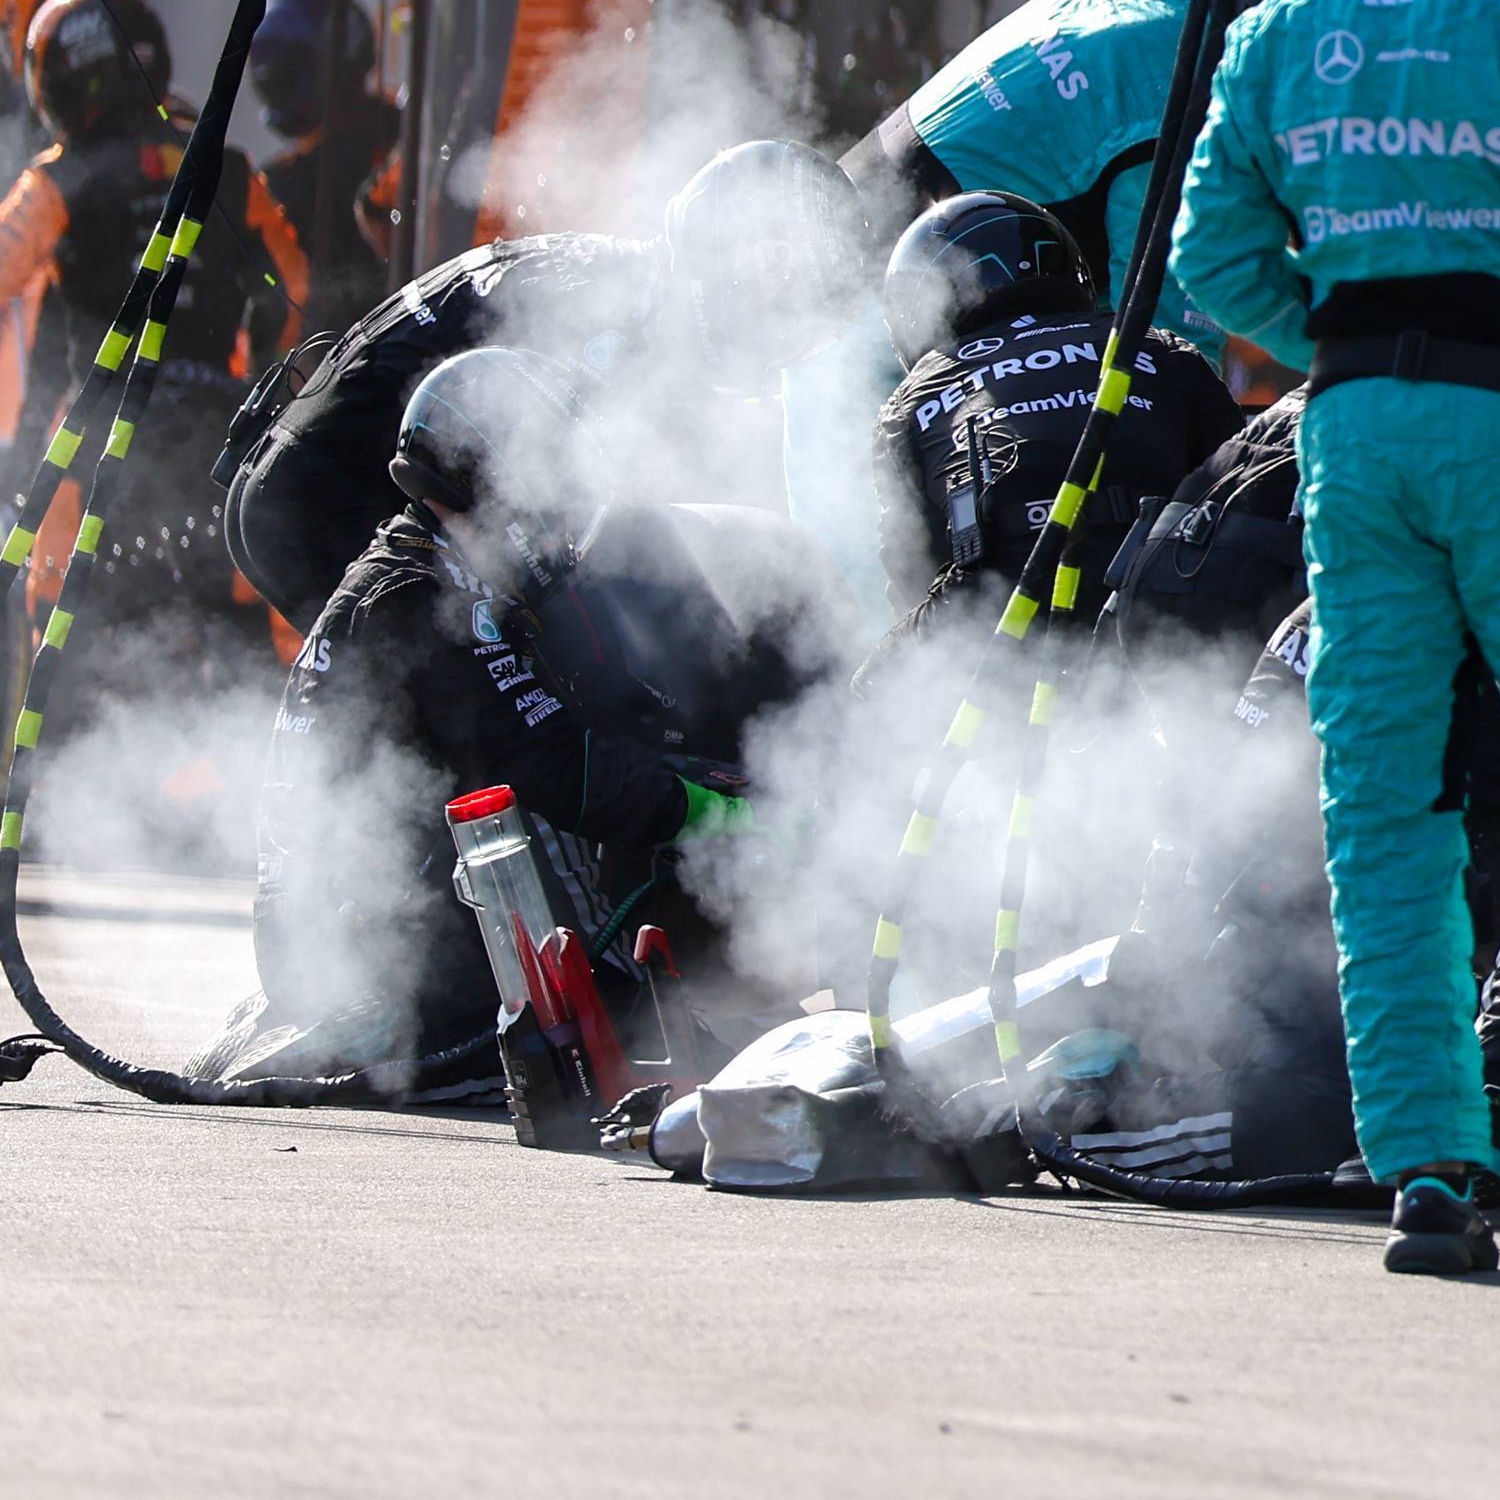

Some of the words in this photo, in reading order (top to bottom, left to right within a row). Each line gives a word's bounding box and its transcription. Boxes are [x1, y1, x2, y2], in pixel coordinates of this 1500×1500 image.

[915, 342, 1157, 432] PETRONS
[976, 388, 1154, 426] TeamVieer
[505, 521, 553, 588] Einhell
